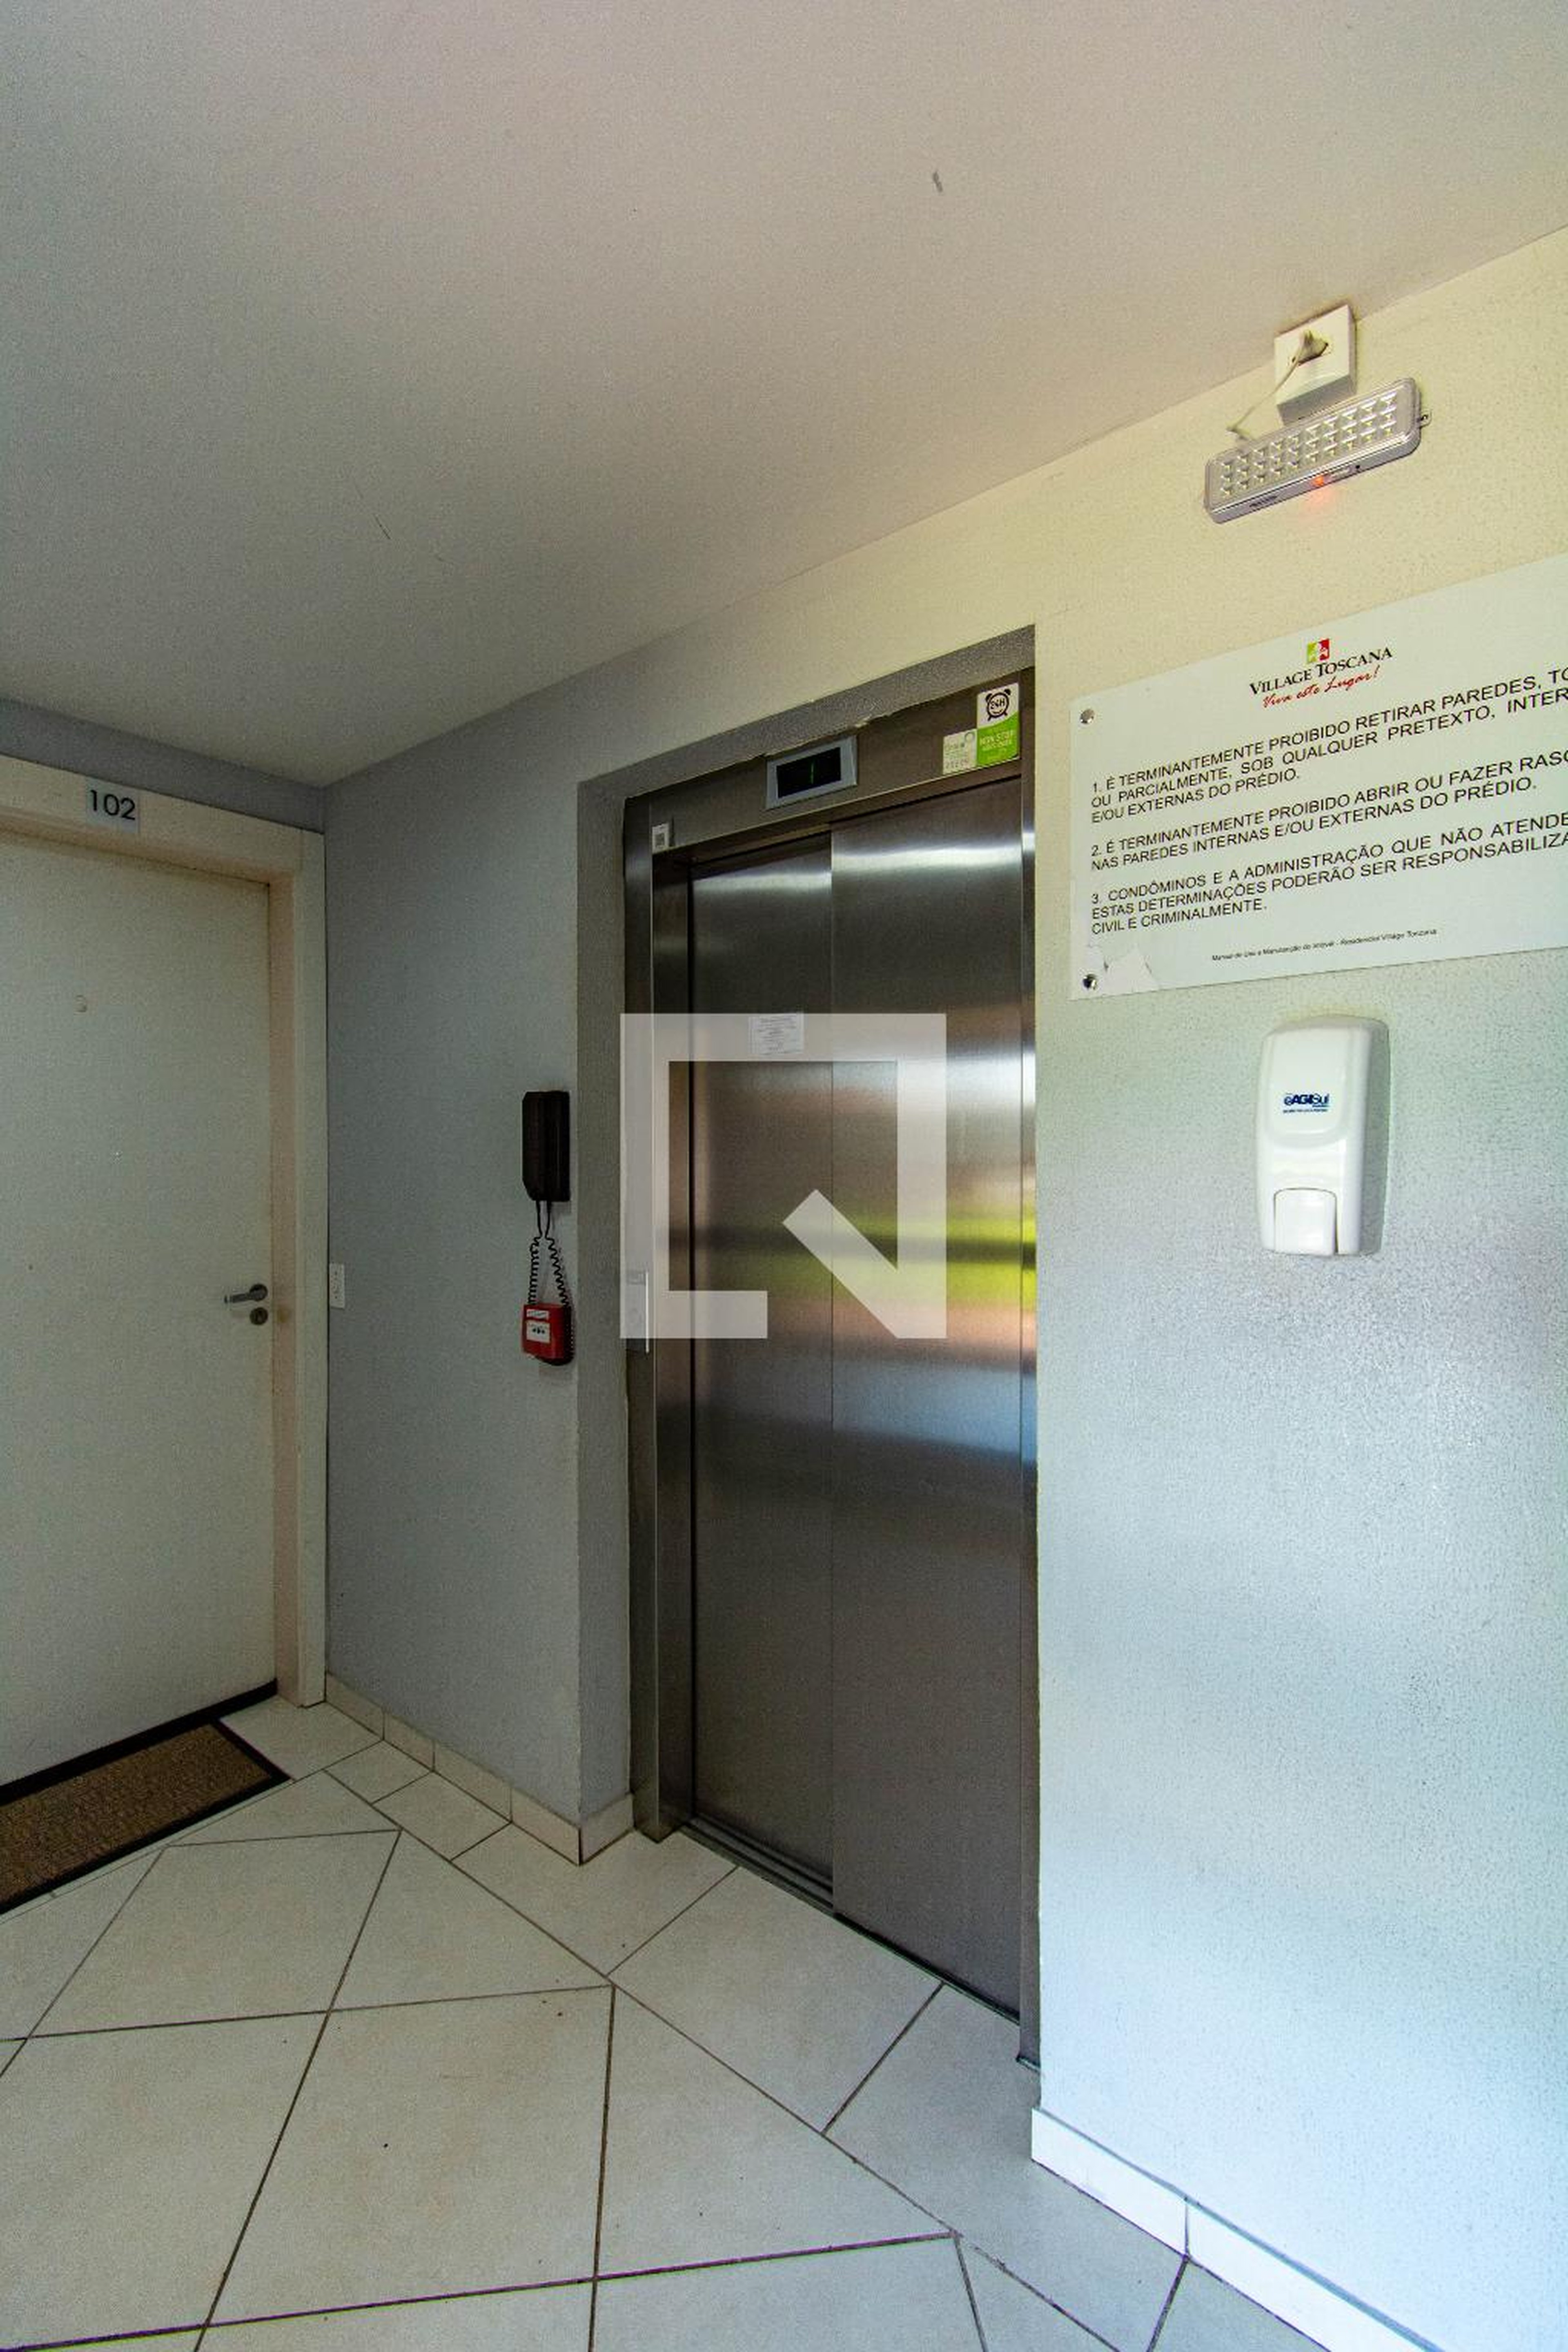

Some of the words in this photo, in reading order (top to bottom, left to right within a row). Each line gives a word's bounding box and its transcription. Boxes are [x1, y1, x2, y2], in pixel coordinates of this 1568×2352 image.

[1250, 669, 1312, 695] VILLAGE
[1315, 647, 1392, 677] TOSCANA
[1091, 795, 1111, 808] OU
[1241, 756, 1273, 774] SOB
[1283, 732, 1377, 764] QUALQUER
[1389, 706, 1495, 740] PRETEXTO,
[1508, 687, 1568, 713] INTER
[1106, 776, 1115, 790] É
[1119, 741, 1264, 786] TERMINANTEMENTE
[1269, 721, 1350, 751] PROIBIDO
[1356, 699, 1436, 730] RETIRAR
[90, 789, 136, 820] 102
[1091, 808, 1124, 823] E/OU
[1128, 789, 1204, 815] EXTERNAS
[1209, 783, 1231, 798] DO
[1235, 768, 1299, 792] PRÉDIO.
[1092, 857, 1118, 870] NAS
[1123, 842, 1188, 865] PAREDES
[1193, 827, 1269, 852] INTERNAS
[1274, 818, 1314, 837] E/OU
[1319, 799, 1414, 829] EXTERNAS
[1421, 793, 1448, 809] DO
[1454, 777, 1537, 803] PRÉDIO.
[1106, 840, 1115, 853] É
[1119, 811, 1264, 850] TERMINANTEMENTE
[1269, 794, 1350, 821] PROIBIDO
[1354, 782, 1409, 804] ABRIR
[1415, 775, 1442, 792] OU
[1450, 761, 1512, 786] FAZER
[1092, 903, 1134, 919] ESTAS
[1138, 882, 1267, 912] DETERMINAÇÕES
[1272, 866, 1354, 891] PODERÃO
[1361, 860, 1396, 877] SER
[1108, 875, 1206, 901] CONDÔMINOS
[1214, 871, 1223, 884] E
[1229, 869, 1239, 881] A
[1244, 844, 1383, 878] ADMINISTRAÇÃO
[1392, 836, 1431, 853] QUE
[1441, 827, 1483, 846] NÃO
[1091, 920, 1125, 935] CIVIL
[1128, 918, 1137, 929] E
[1141, 900, 1267, 927] CRIMINALMENTE.
